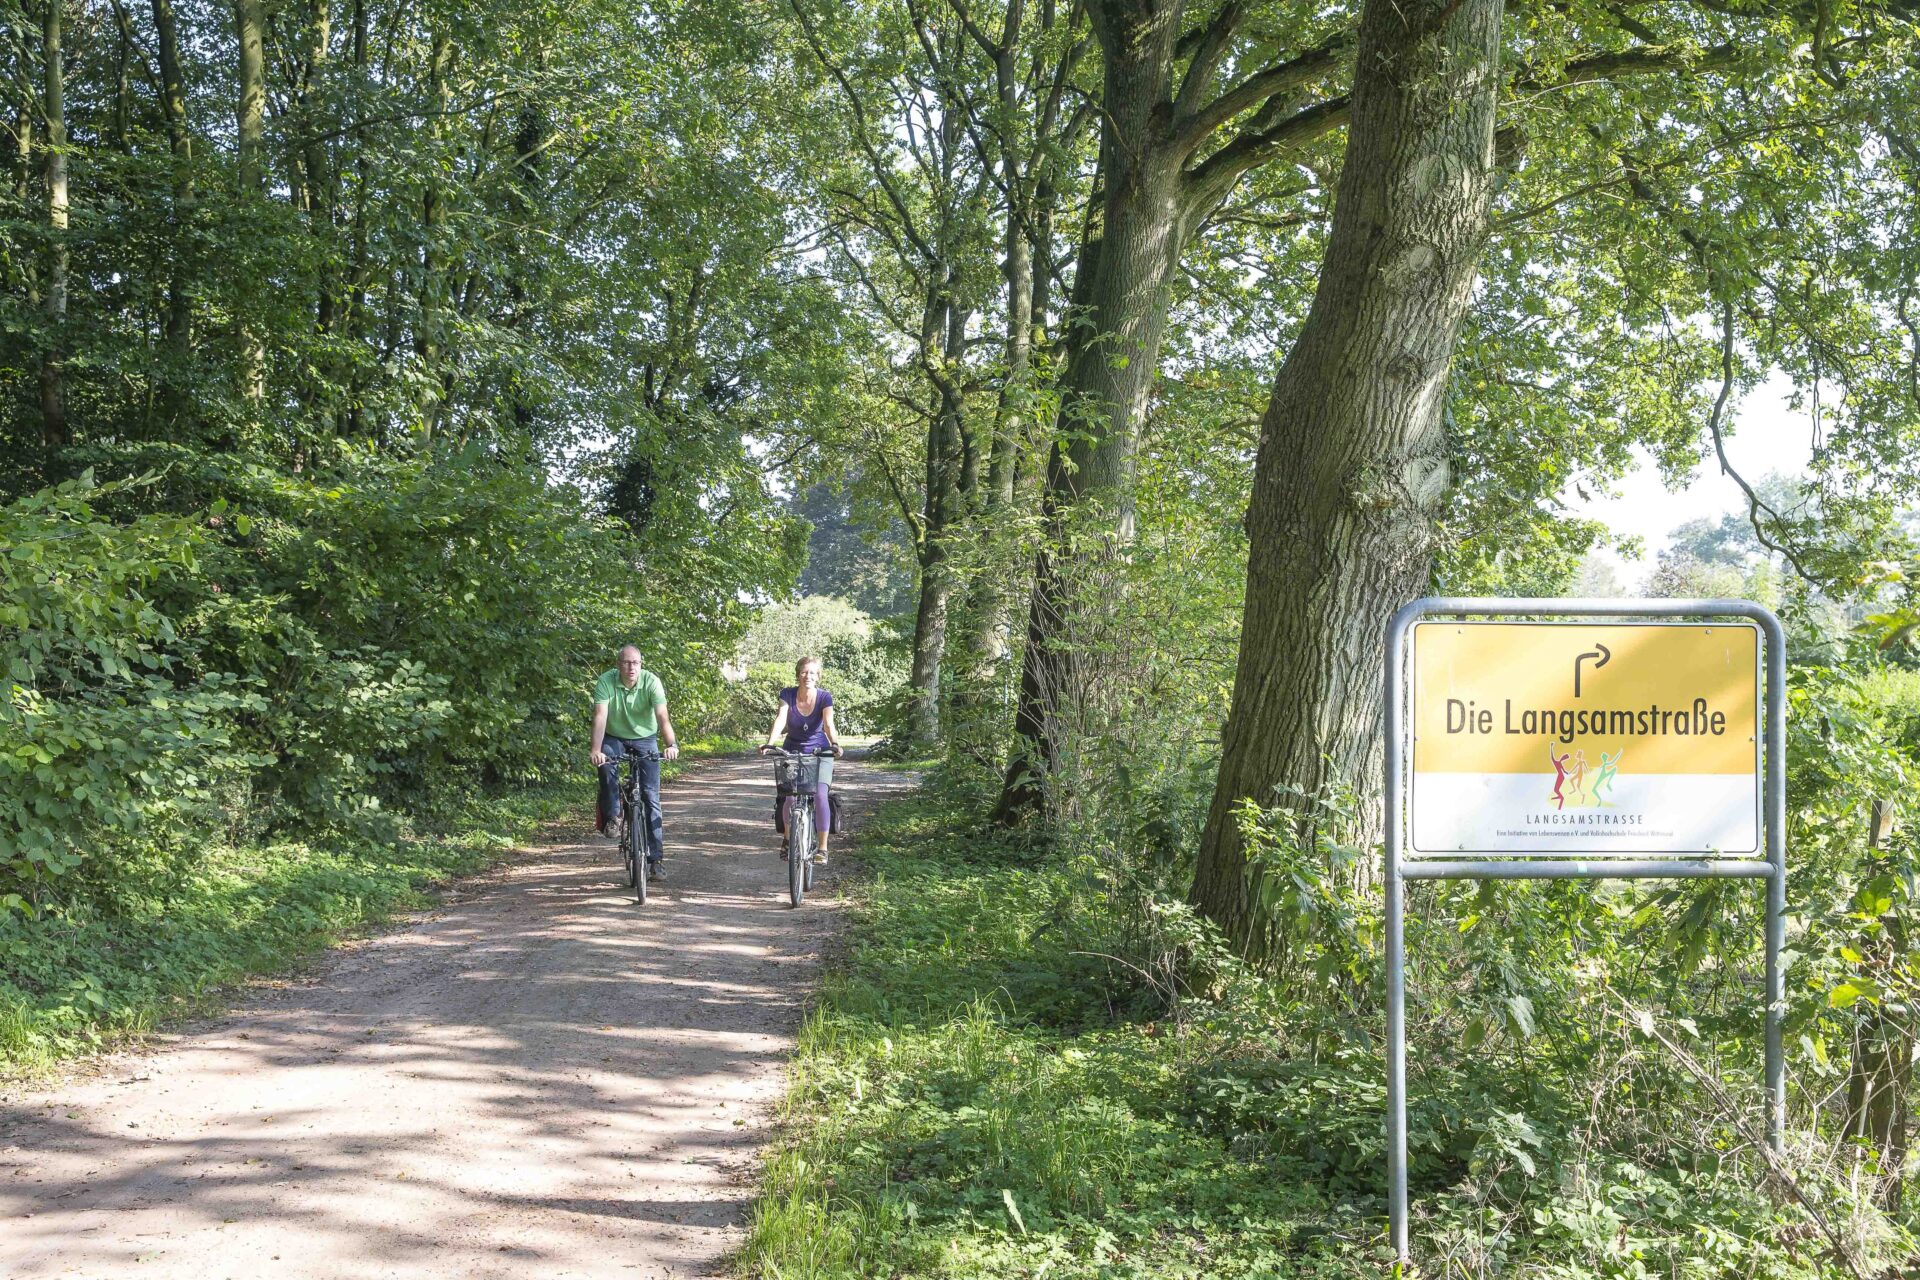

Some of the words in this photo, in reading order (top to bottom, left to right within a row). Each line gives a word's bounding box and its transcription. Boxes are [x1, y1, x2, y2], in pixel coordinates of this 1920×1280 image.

[1446, 698, 1493, 734] Die
[1505, 698, 1726, 743] Langsamstraße
[1526, 814, 1643, 825] LANGSAMSTRASSE
